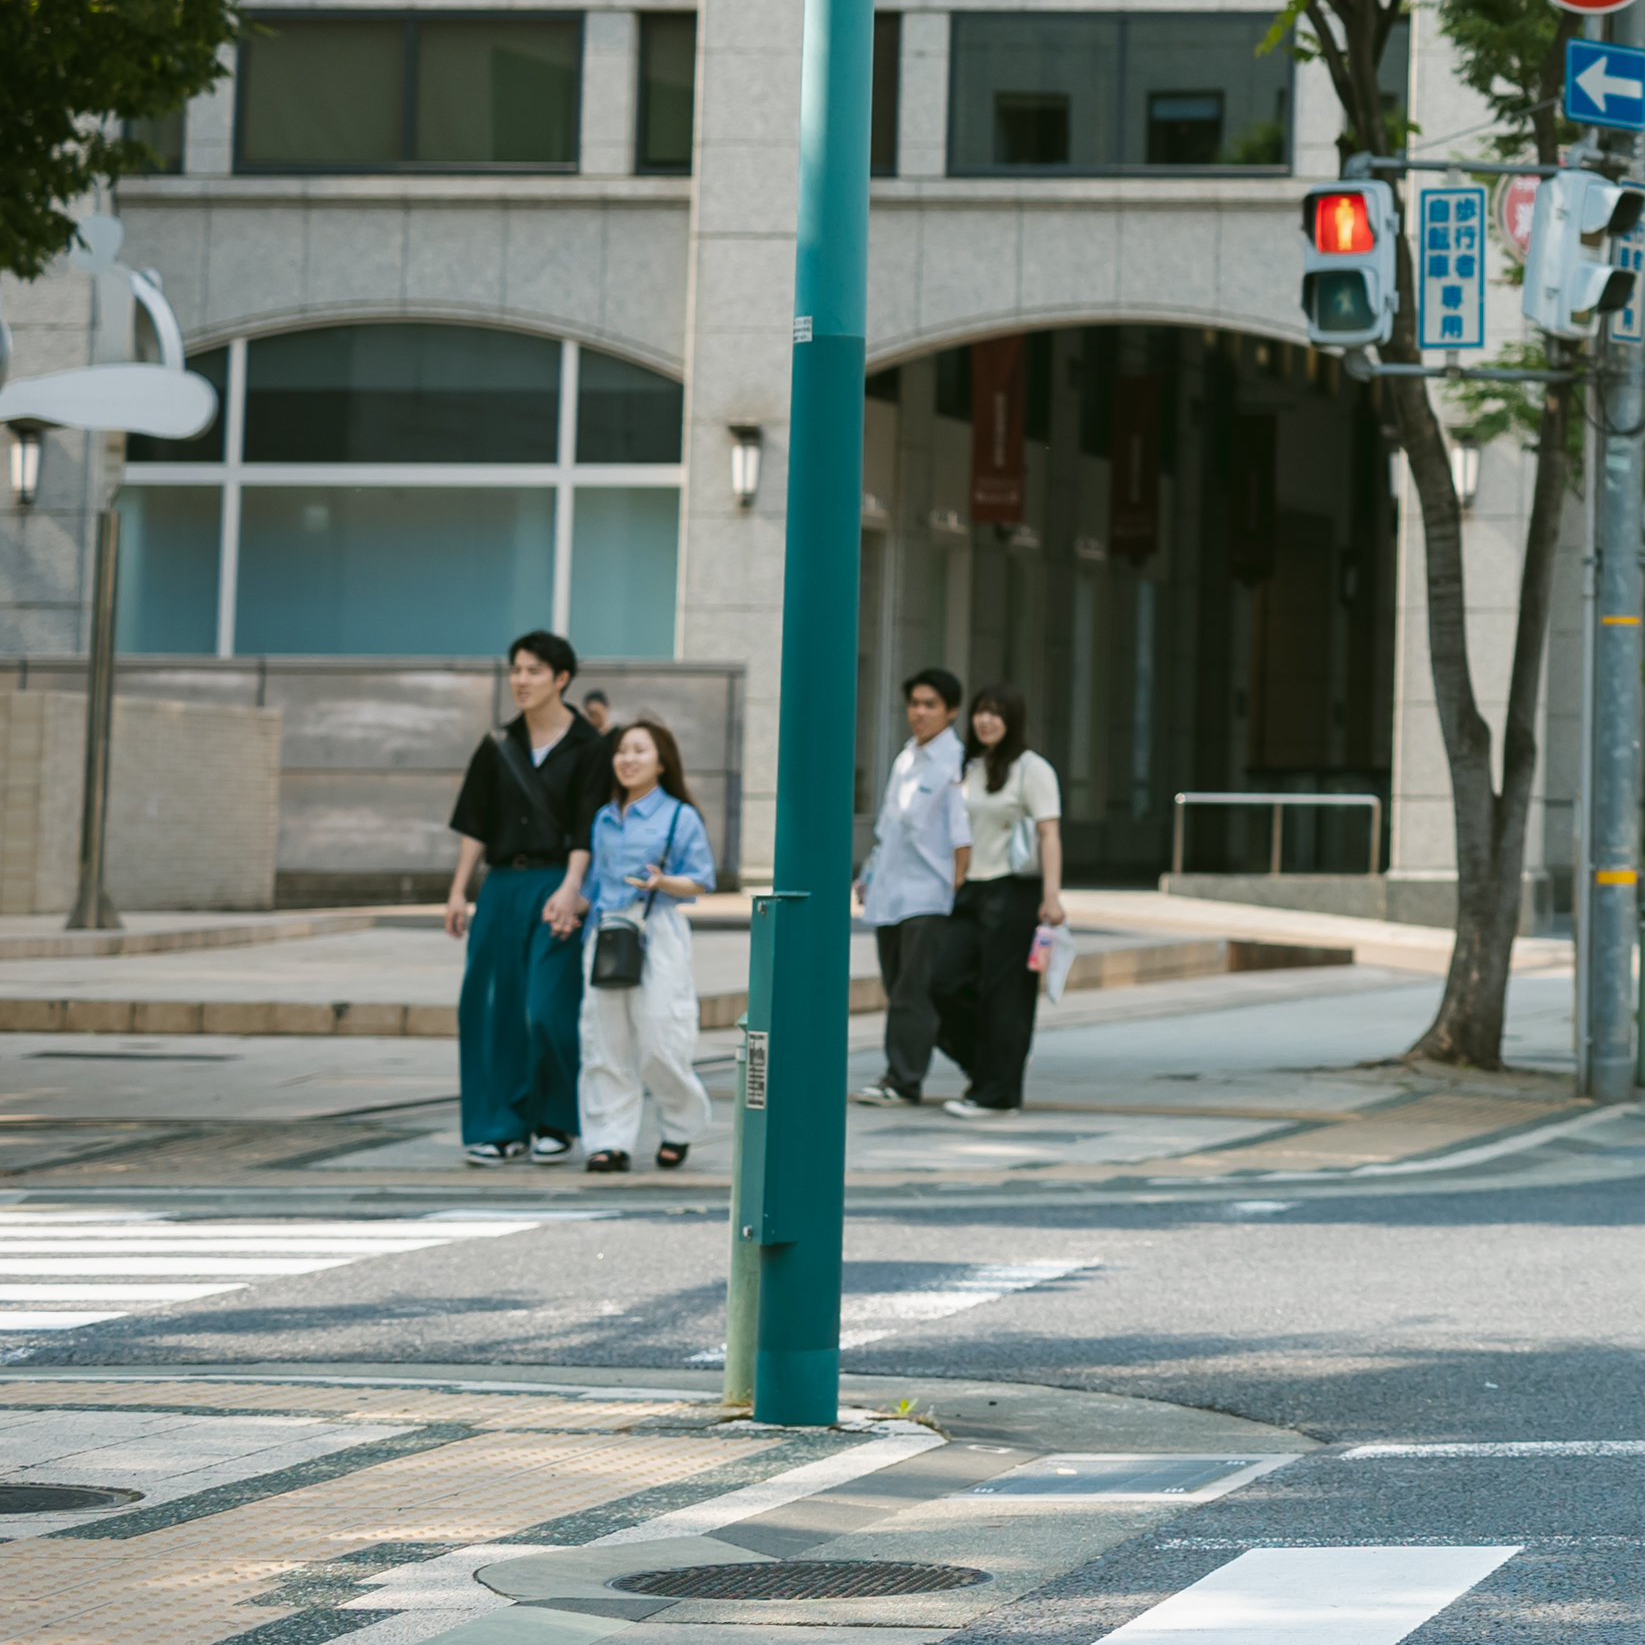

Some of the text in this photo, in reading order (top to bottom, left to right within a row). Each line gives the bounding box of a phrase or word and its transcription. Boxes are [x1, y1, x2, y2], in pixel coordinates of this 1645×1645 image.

[1428, 199, 1450, 279] 自転車
[1455, 198, 1476, 279] 歩行者
[1441, 285, 1463, 339] 専用
